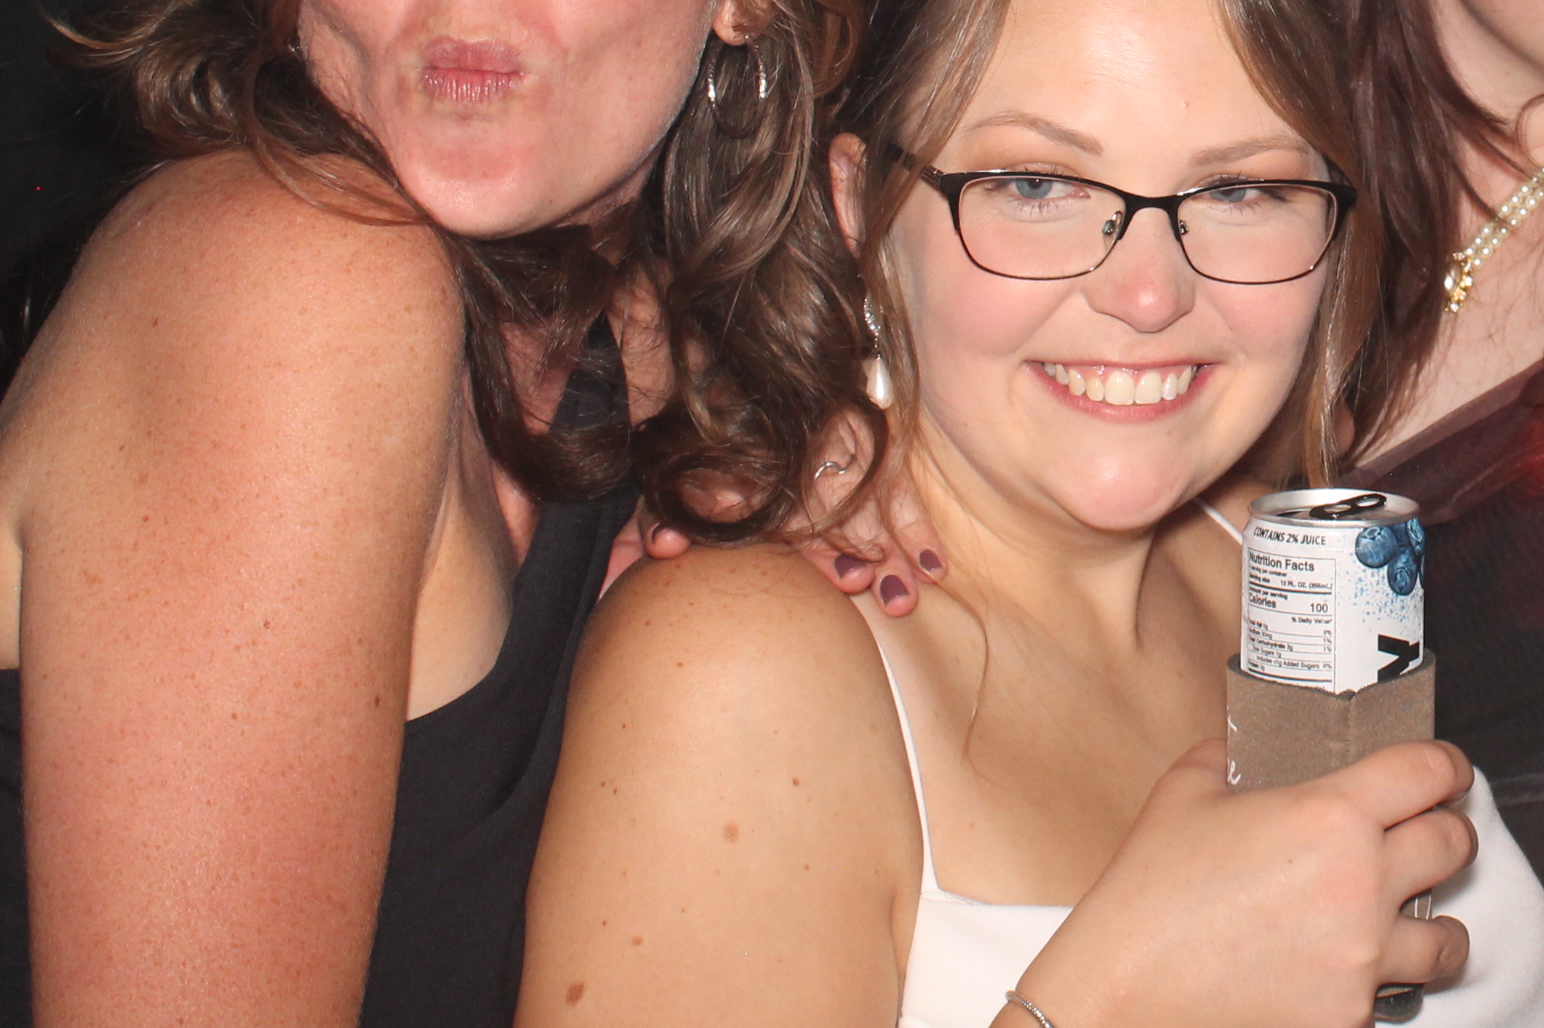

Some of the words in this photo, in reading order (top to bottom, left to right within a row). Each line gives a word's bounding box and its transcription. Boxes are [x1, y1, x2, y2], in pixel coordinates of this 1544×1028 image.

[1253, 526, 1285, 542] CONTAINS
[1286, 533, 1299, 543] 2%
[1300, 534, 1326, 545] JUICE
[1249, 551, 1282, 569] Nutrition
[1285, 558, 1315, 572] Facts
[1249, 592, 1277, 608] Calories
[1310, 603, 1328, 613] 100
[1298, 617, 1312, 625] Daily
[1301, 661, 1320, 670] Sugars
